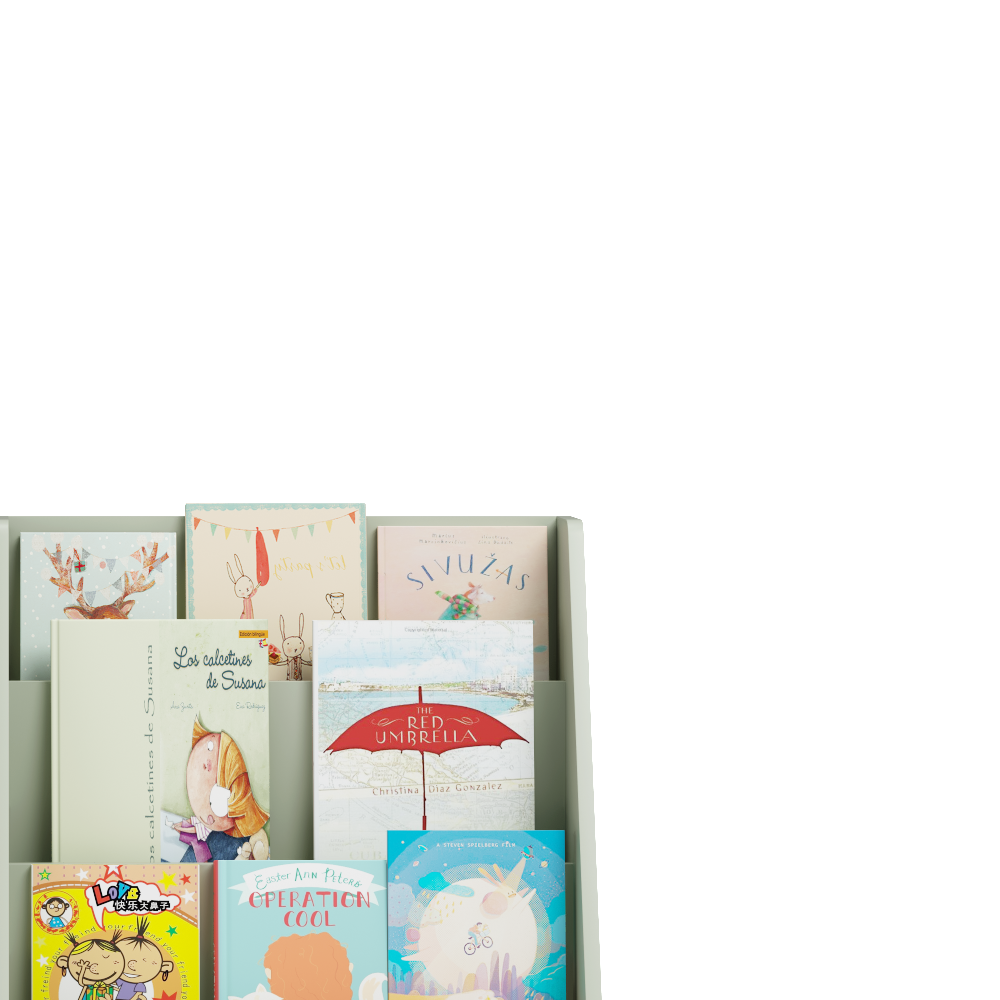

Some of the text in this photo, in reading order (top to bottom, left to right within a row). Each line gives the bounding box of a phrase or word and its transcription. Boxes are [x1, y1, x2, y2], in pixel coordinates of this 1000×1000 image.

[406, 552, 530, 591] SIVUŽAS
[173, 646, 252, 670] Los calcetines
[143, 645, 155, 717] Susana
[206, 670, 266, 690] de Susana
[416, 707, 434, 715] THE
[408, 715, 444, 730] RED
[144, 722, 154, 744] de
[375, 730, 478, 746] UMBRELLA
[144, 750, 155, 840] calcetines
[254, 872, 292, 890] Easter
[114, 900, 171, 911] 快乐大鼻子
[249, 891, 371, 908] OPERATION
[284, 910, 336, 927] COOL
